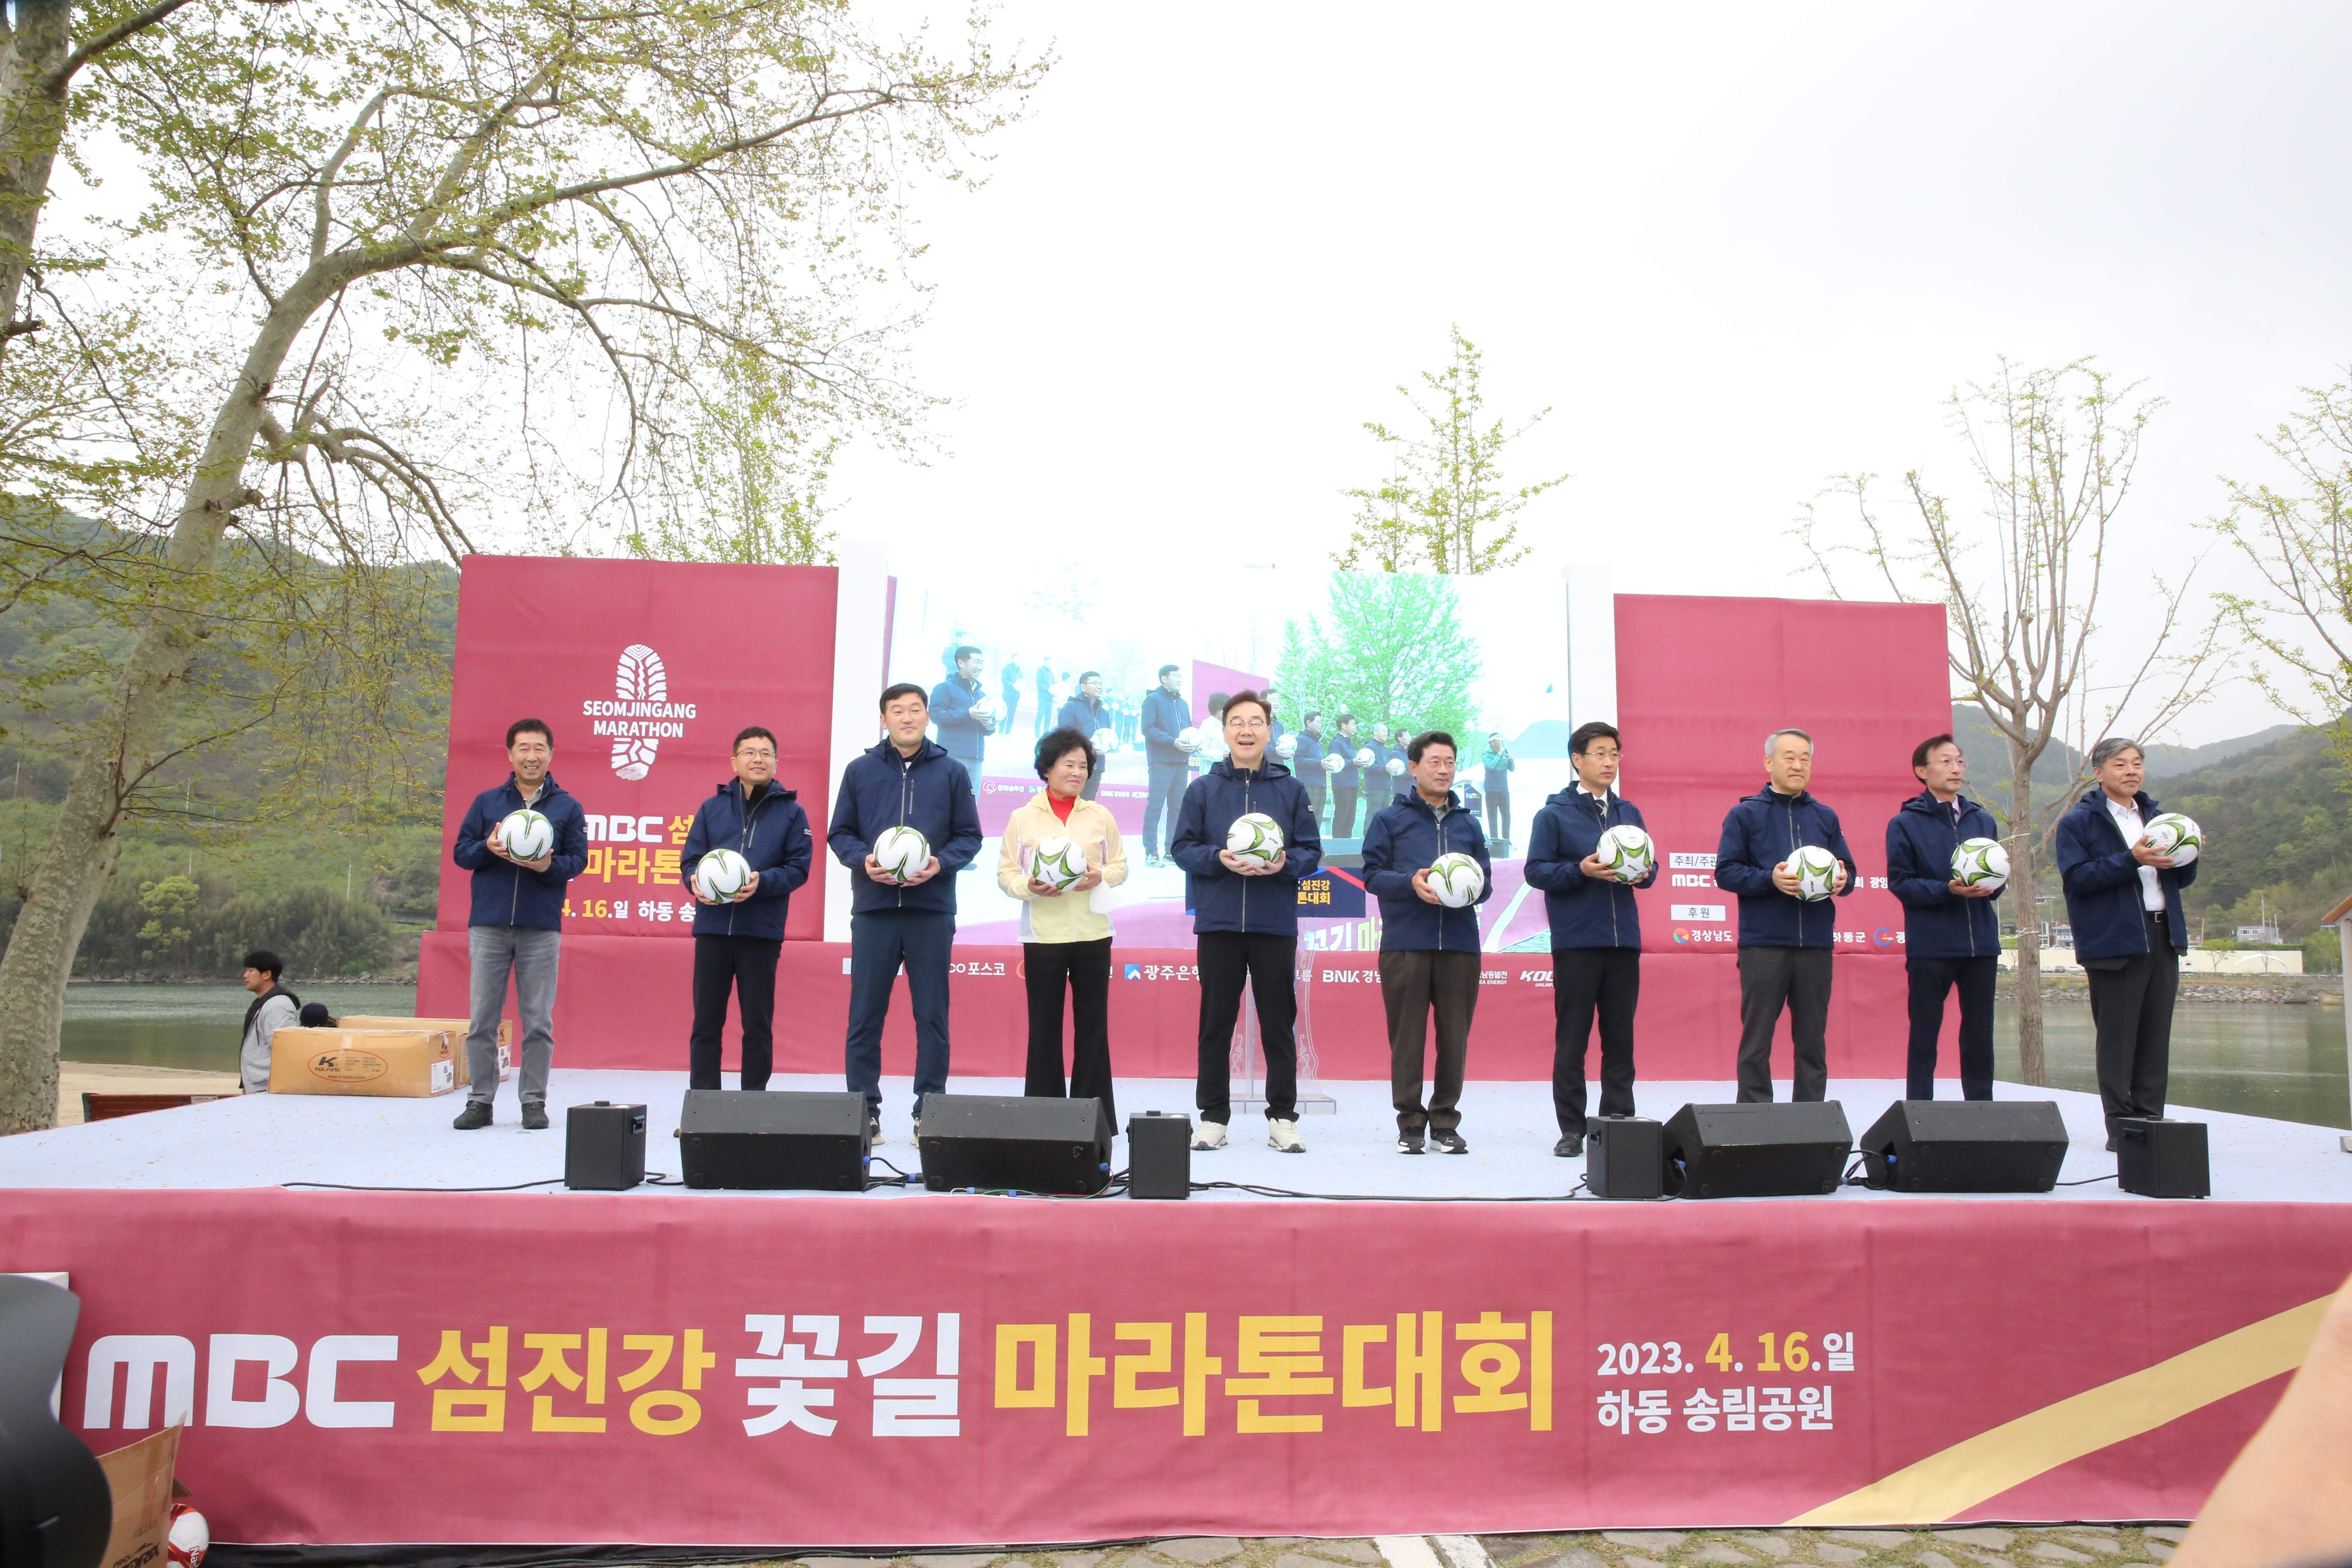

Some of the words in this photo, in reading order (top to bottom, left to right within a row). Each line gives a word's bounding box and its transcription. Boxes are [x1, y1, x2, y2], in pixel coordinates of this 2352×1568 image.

[583, 700, 696, 719] SEOMJINGANG
[593, 720, 684, 737] MARATHON
[584, 814, 664, 843] MBC
[1301, 880, 1331, 891] 섬진강
[1672, 874, 1711, 887] MBC
[582, 899, 629, 919] 16.일
[638, 900, 674, 922] 하동
[1691, 930, 1733, 942] 경상남도
[967, 962, 1005, 976] 포스코
[1323, 970, 1360, 983] BNK
[1597, 1341, 1694, 1376] 2023.
[1705, 1332, 1744, 1372] 4.
[1757, 1331, 1855, 1372] 16.일
[84, 1334, 399, 1429] MBC
[416, 1325, 715, 1435] 섬진강
[735, 1312, 960, 1437] 꽃길
[994, 1311, 1552, 1436] 마라톤대회
[1597, 1389, 1671, 1434] 하동
[1683, 1385, 1833, 1432] 송림공원
